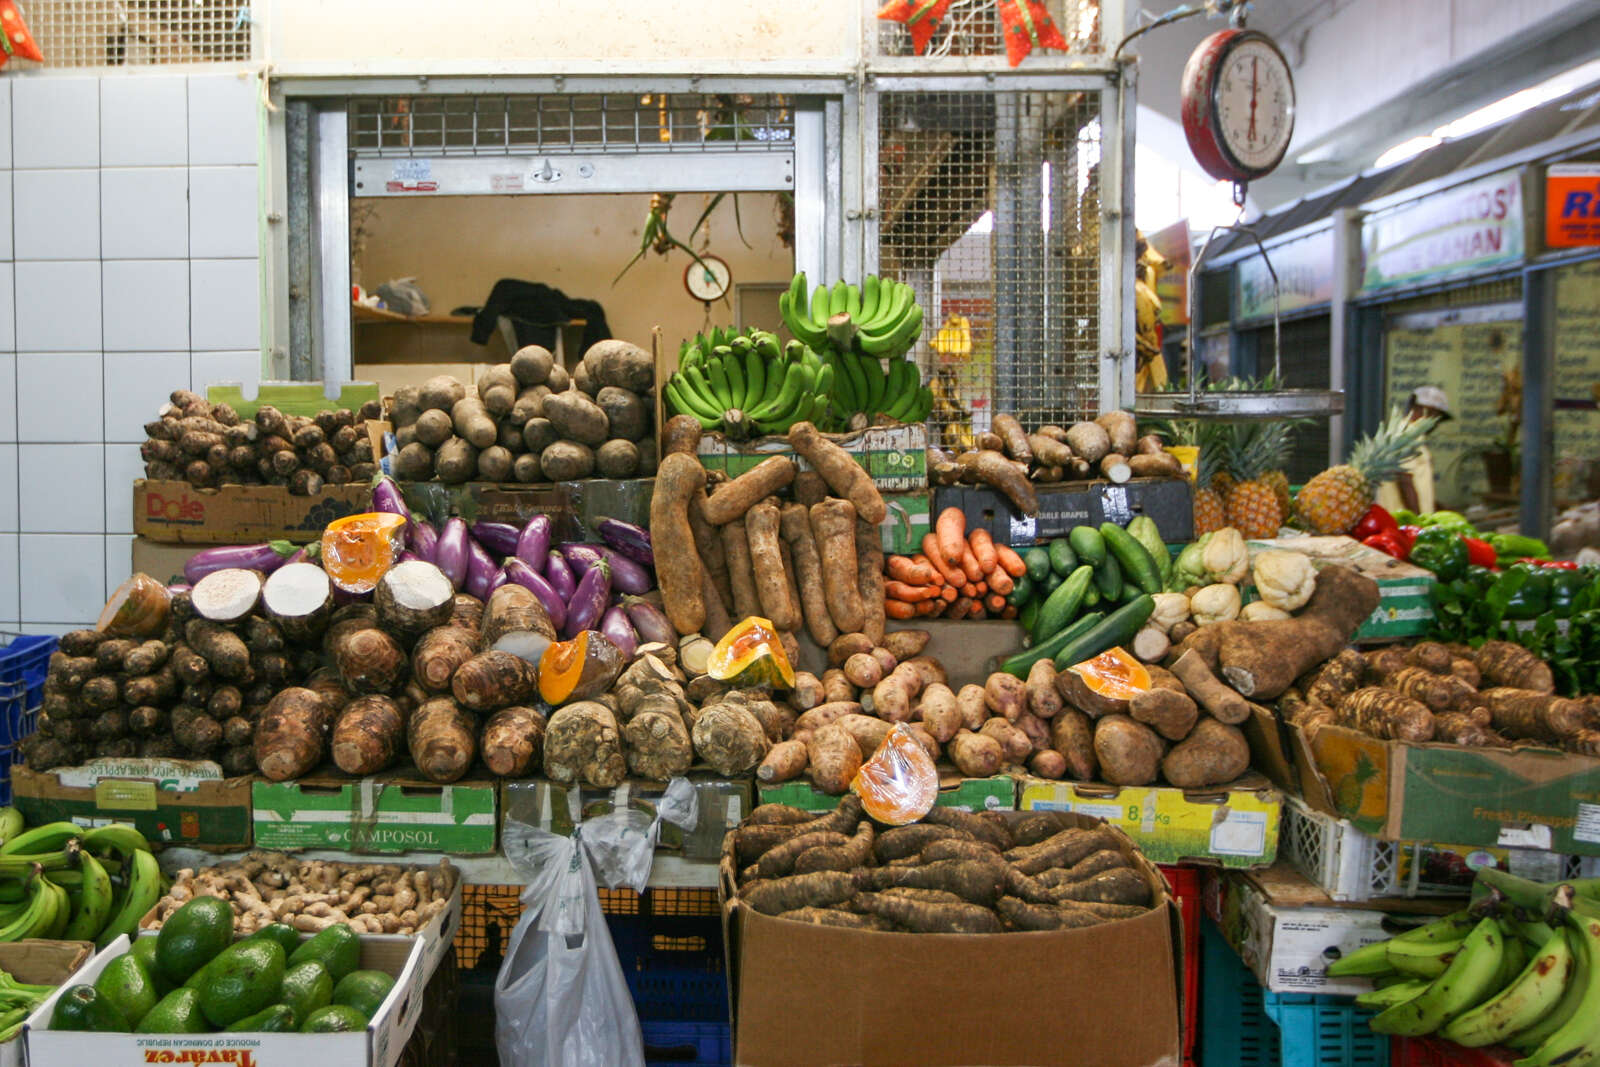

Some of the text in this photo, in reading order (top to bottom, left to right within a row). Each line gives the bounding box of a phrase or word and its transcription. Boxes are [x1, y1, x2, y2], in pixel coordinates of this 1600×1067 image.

[147, 493, 205, 520] Dole
[1061, 510, 1089, 519] GRAPES
[152, 766, 176, 778] RICO
[1472, 807, 1512, 822] Fresh
[343, 829, 439, 845] CAMPOSOL
[137, 1039, 260, 1047] PRODUCE OF DOMINICAN REPUBLIC
[144, 1048, 257, 1067] Tavárez
